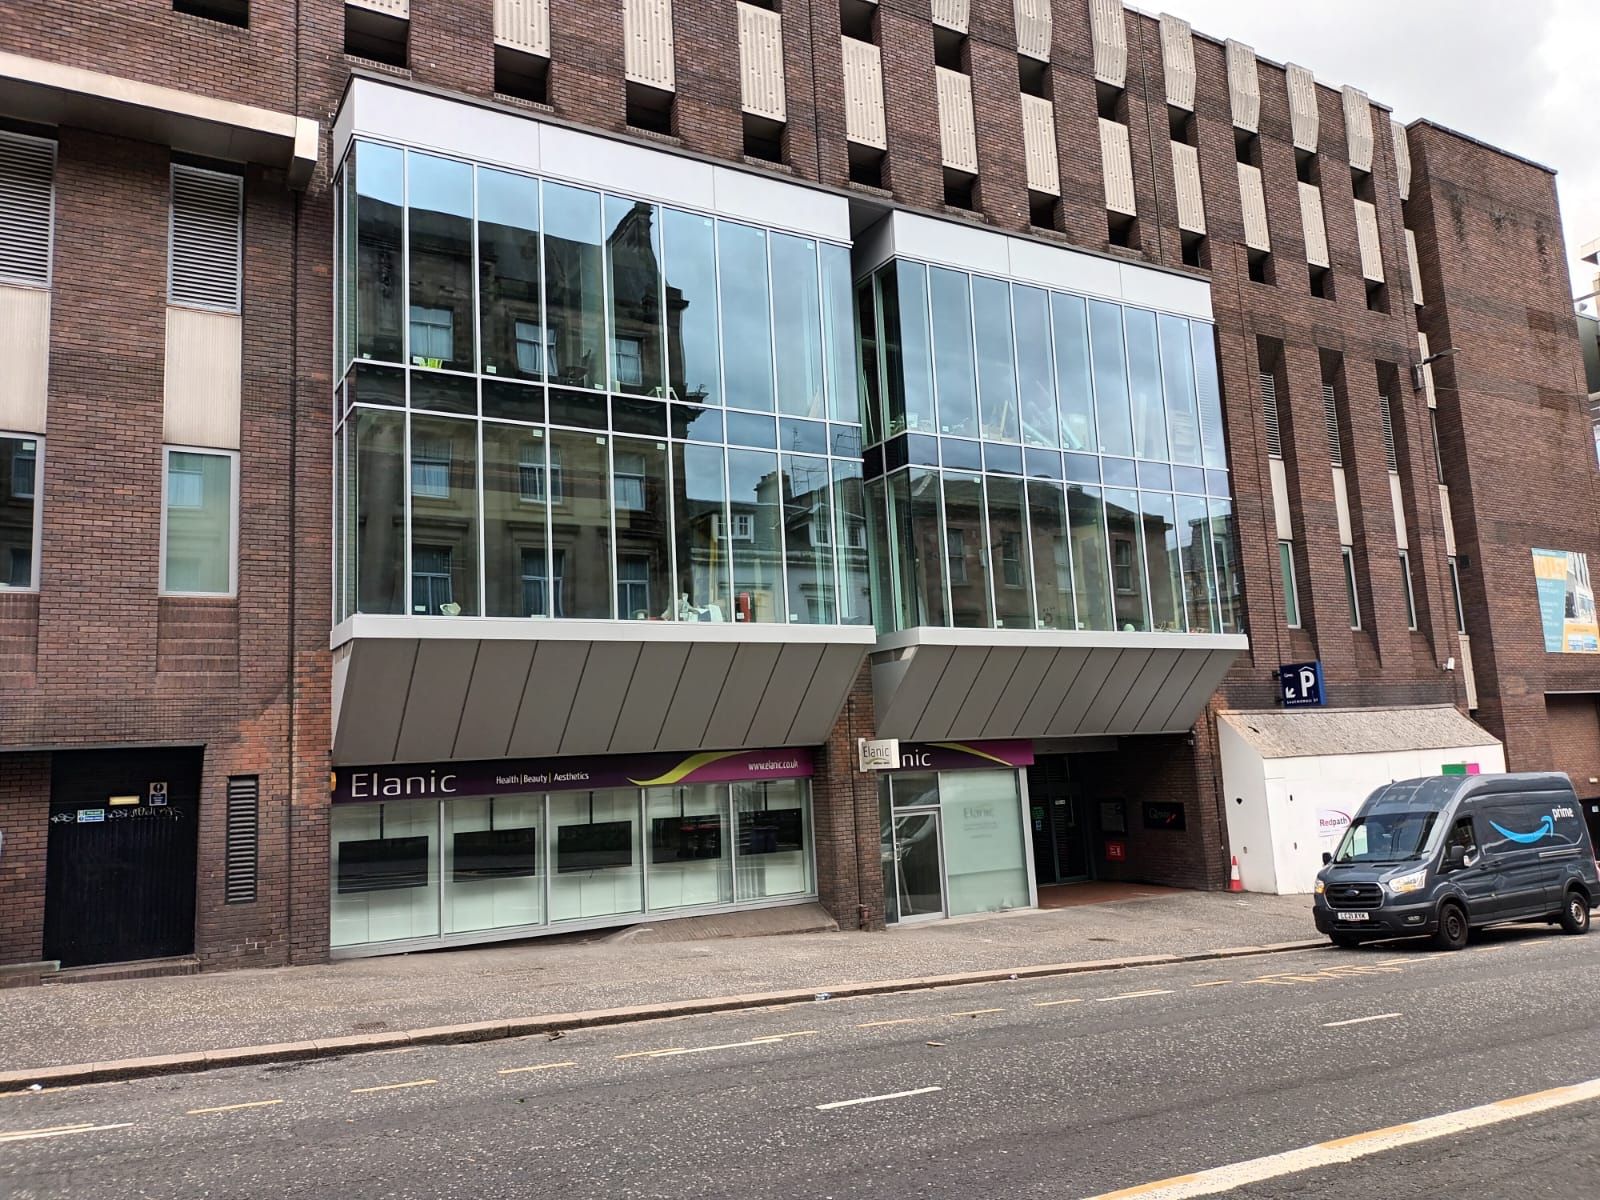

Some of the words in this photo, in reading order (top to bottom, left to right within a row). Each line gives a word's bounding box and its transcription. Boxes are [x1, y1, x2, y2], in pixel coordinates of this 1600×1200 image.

[1300, 671, 1315, 697] P
[863, 744, 889, 758] Elanic
[902, 749, 931, 767] nic
[748, 760, 799, 771] www.elanic.co.uk
[352, 770, 457, 797] Elanic
[496, 775, 519, 785] Health
[523, 774, 547, 784] Beauty
[554, 772, 590, 781] Aesthetics
[1552, 805, 1574, 821] prime
[1320, 816, 1347, 827] Redpath
